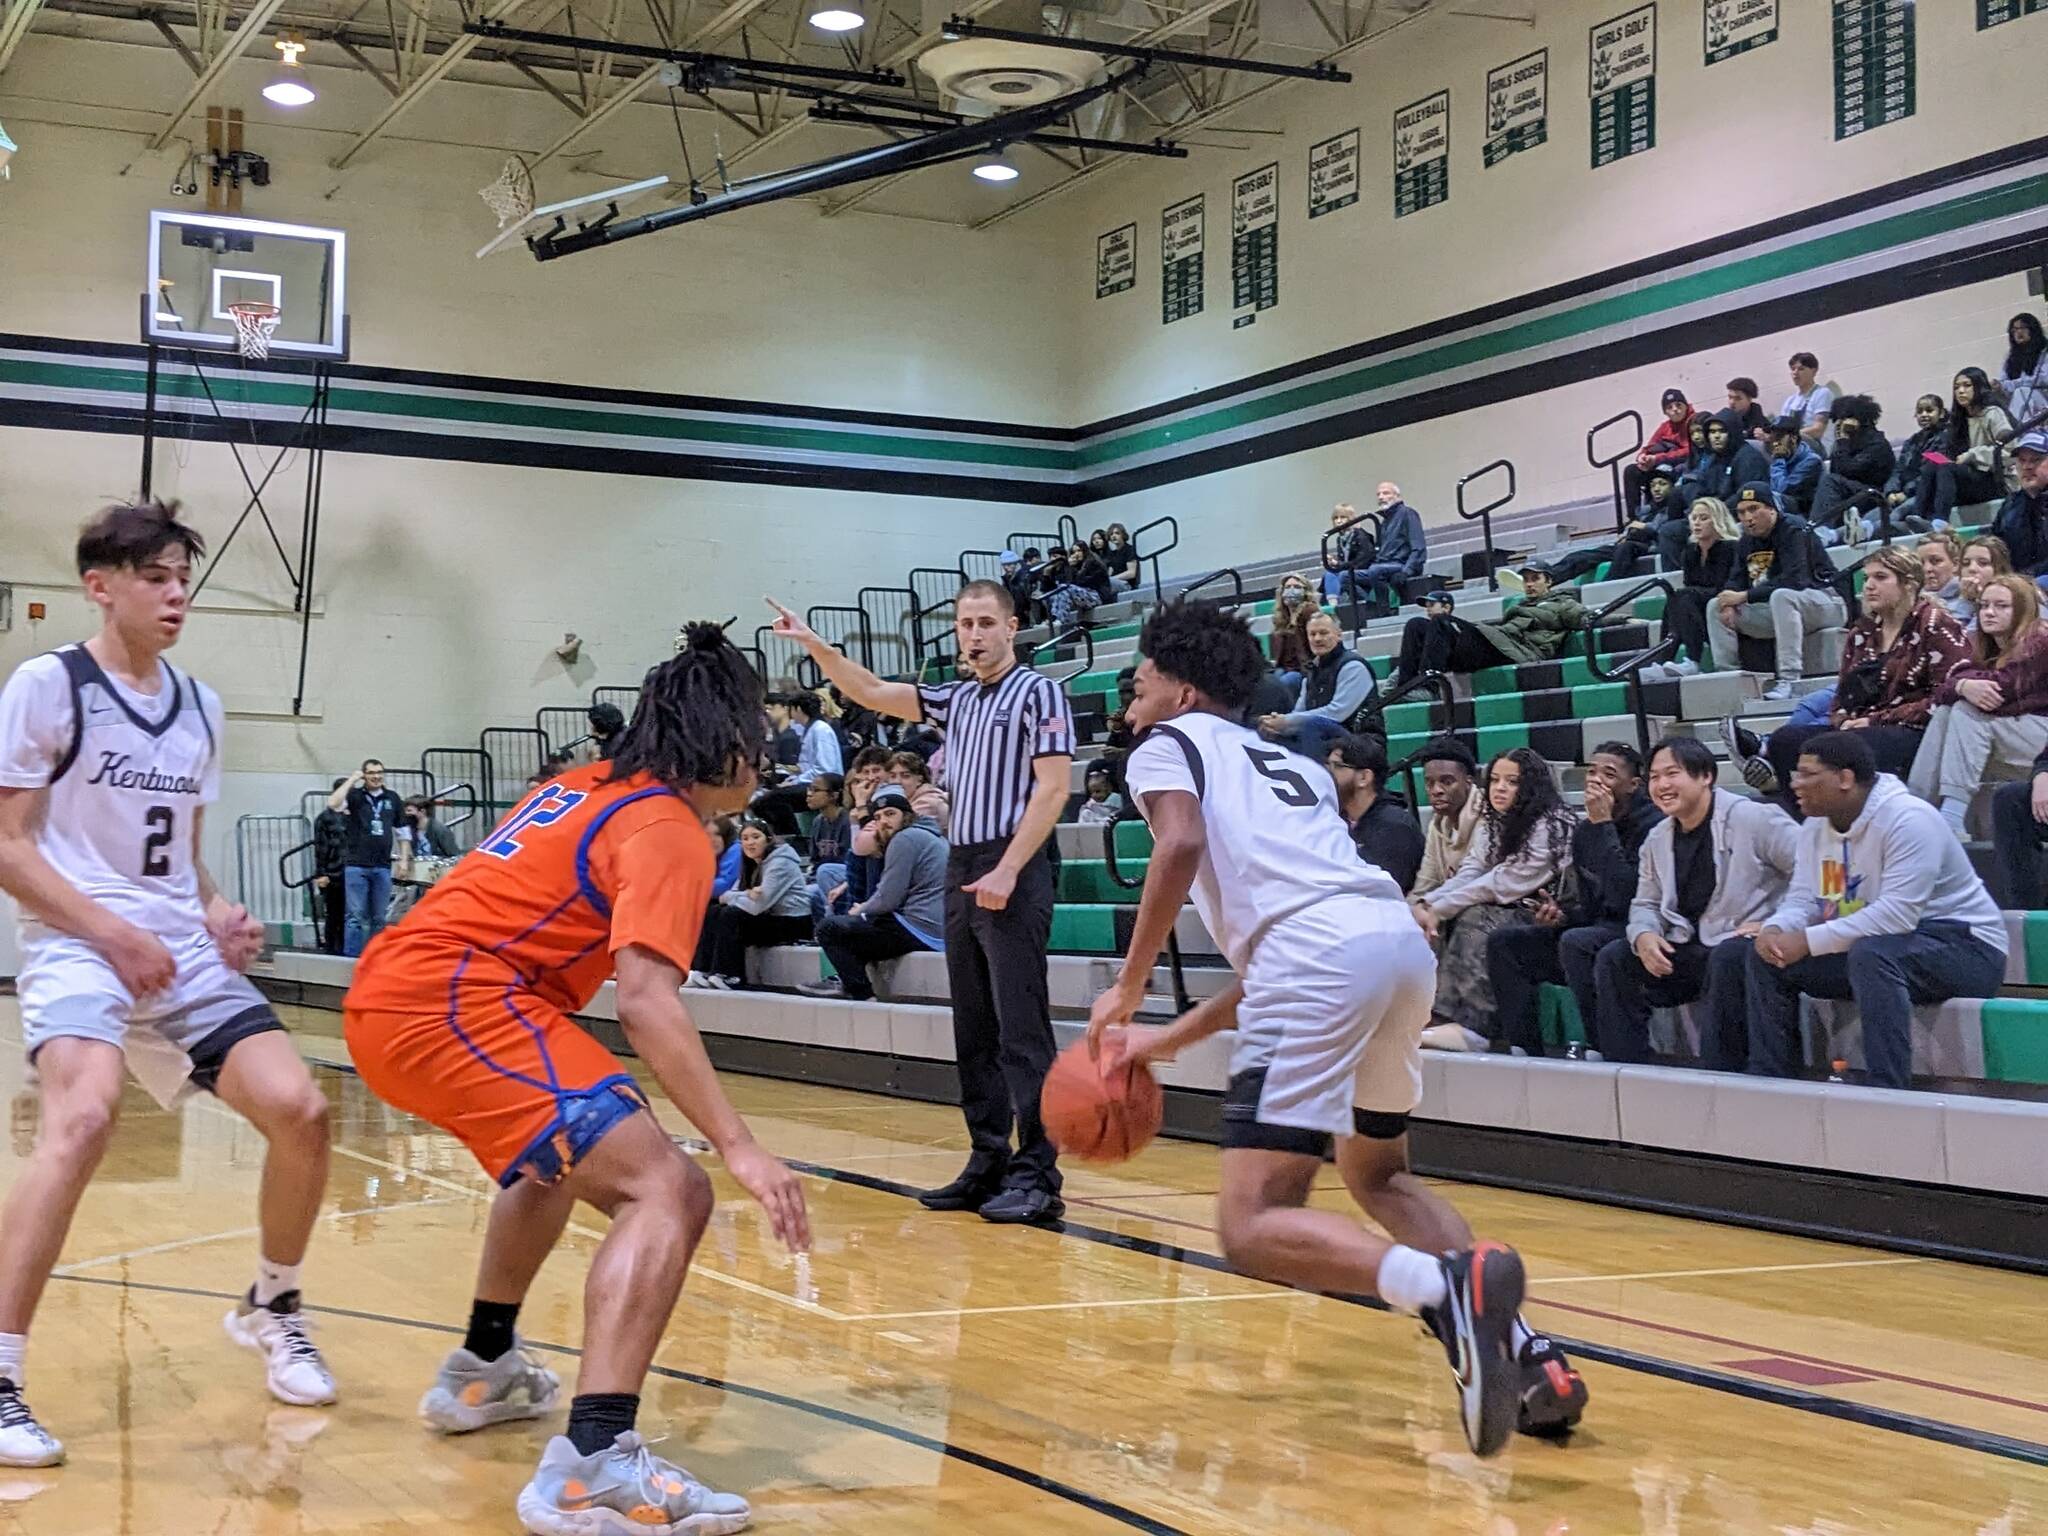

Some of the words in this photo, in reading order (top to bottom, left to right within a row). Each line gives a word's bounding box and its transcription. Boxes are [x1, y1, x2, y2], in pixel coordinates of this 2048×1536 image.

[1729, 5, 1773, 31] CHAMPIONS
[1596, 27, 1623, 50] GIRLS
[1626, 16, 1648, 38] GOLF
[1619, 43, 1645, 62] LEAGUE
[1490, 74, 1512, 93] GIRLS
[1514, 62, 1544, 84] SOCCER
[1611, 54, 1651, 78] CHAMPIONS
[1506, 97, 1542, 119] CHAMPIONS
[1514, 87, 1537, 104] LEAGUE
[1397, 100, 1445, 129] VOLLEYBALL
[1412, 136, 1445, 157] CHAMPIONS
[1419, 127, 1440, 143] LEAGUE
[1238, 180, 1255, 197] BOYS
[1257, 171, 1273, 189] GOLF
[1241, 743, 1320, 807] 5
[476, 783, 589, 861] 12
[141, 806, 173, 877] 2
